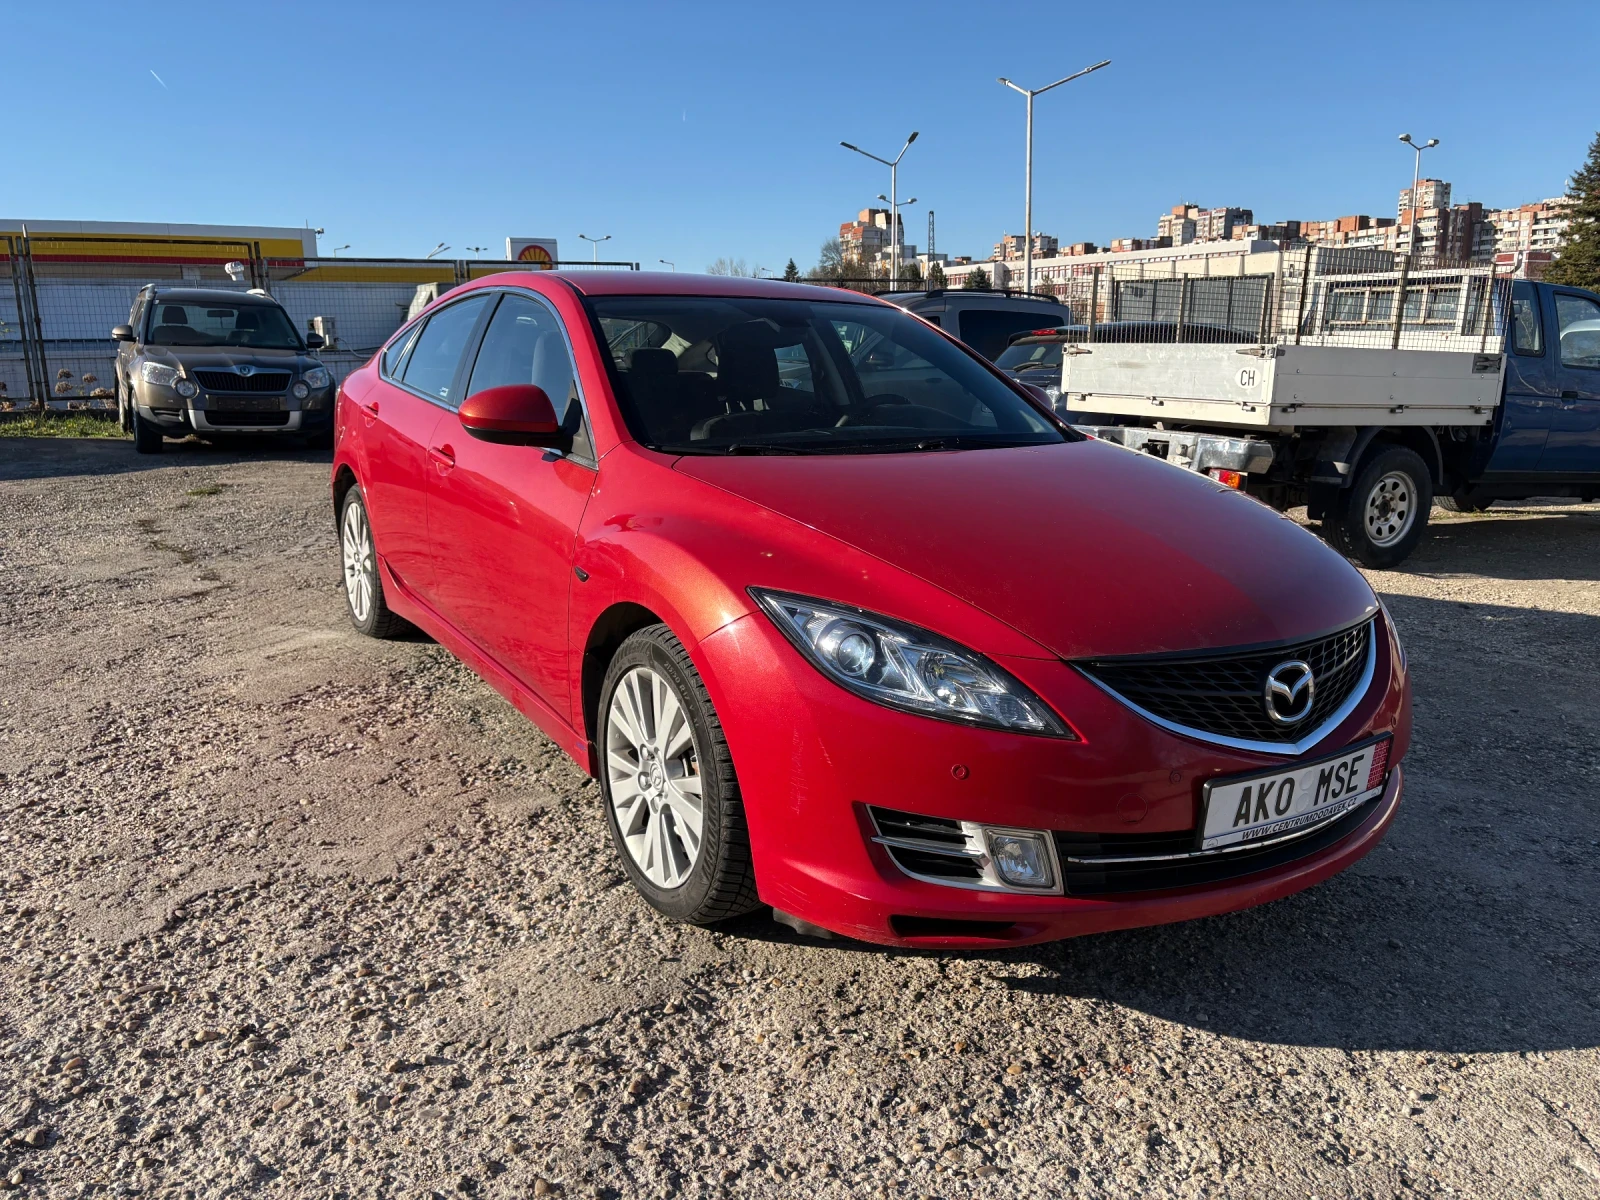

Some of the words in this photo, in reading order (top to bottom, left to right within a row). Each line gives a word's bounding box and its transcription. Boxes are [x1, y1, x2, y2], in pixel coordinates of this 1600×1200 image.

[1240, 369, 1256, 387] CH
[1232, 777, 1296, 828] AKO
[1313, 753, 1366, 806] MSE
[1241, 796, 1358, 841] WWW.CENTRUMDODAVEK.CZ
